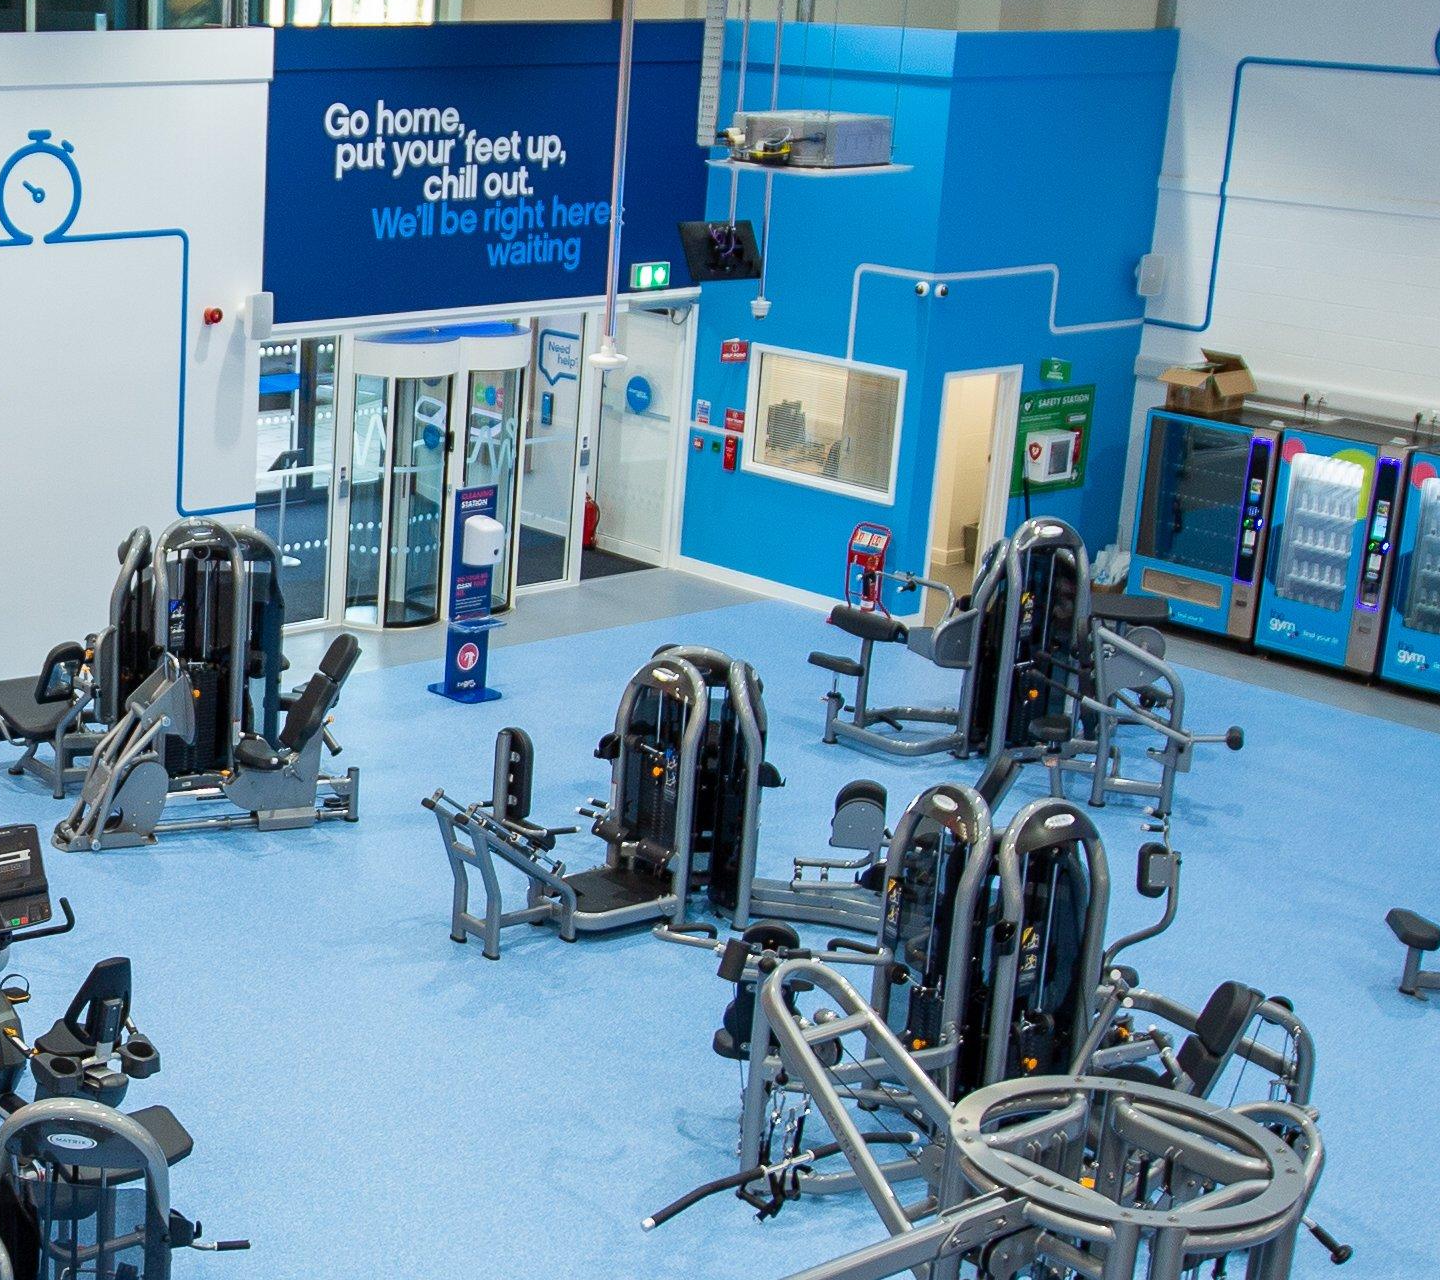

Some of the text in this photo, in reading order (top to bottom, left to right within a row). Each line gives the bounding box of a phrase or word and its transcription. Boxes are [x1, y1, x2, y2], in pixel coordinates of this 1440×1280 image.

[324, 99, 465, 138] Go home,
[335, 129, 566, 181] put your feet up,
[423, 164, 534, 201] chill out.
[371, 202, 434, 240] We'll
[440, 202, 478, 236] be
[483, 197, 545, 241] right
[486, 232, 582, 271] waiting
[548, 341, 571, 355] Need
[1038, 394, 1090, 408] SAFETY STATION
[461, 498, 488, 509] STATION
[1269, 617, 1296, 631] gym
[1397, 649, 1426, 664] gym
[55, 1136, 87, 1145] MATRIX
